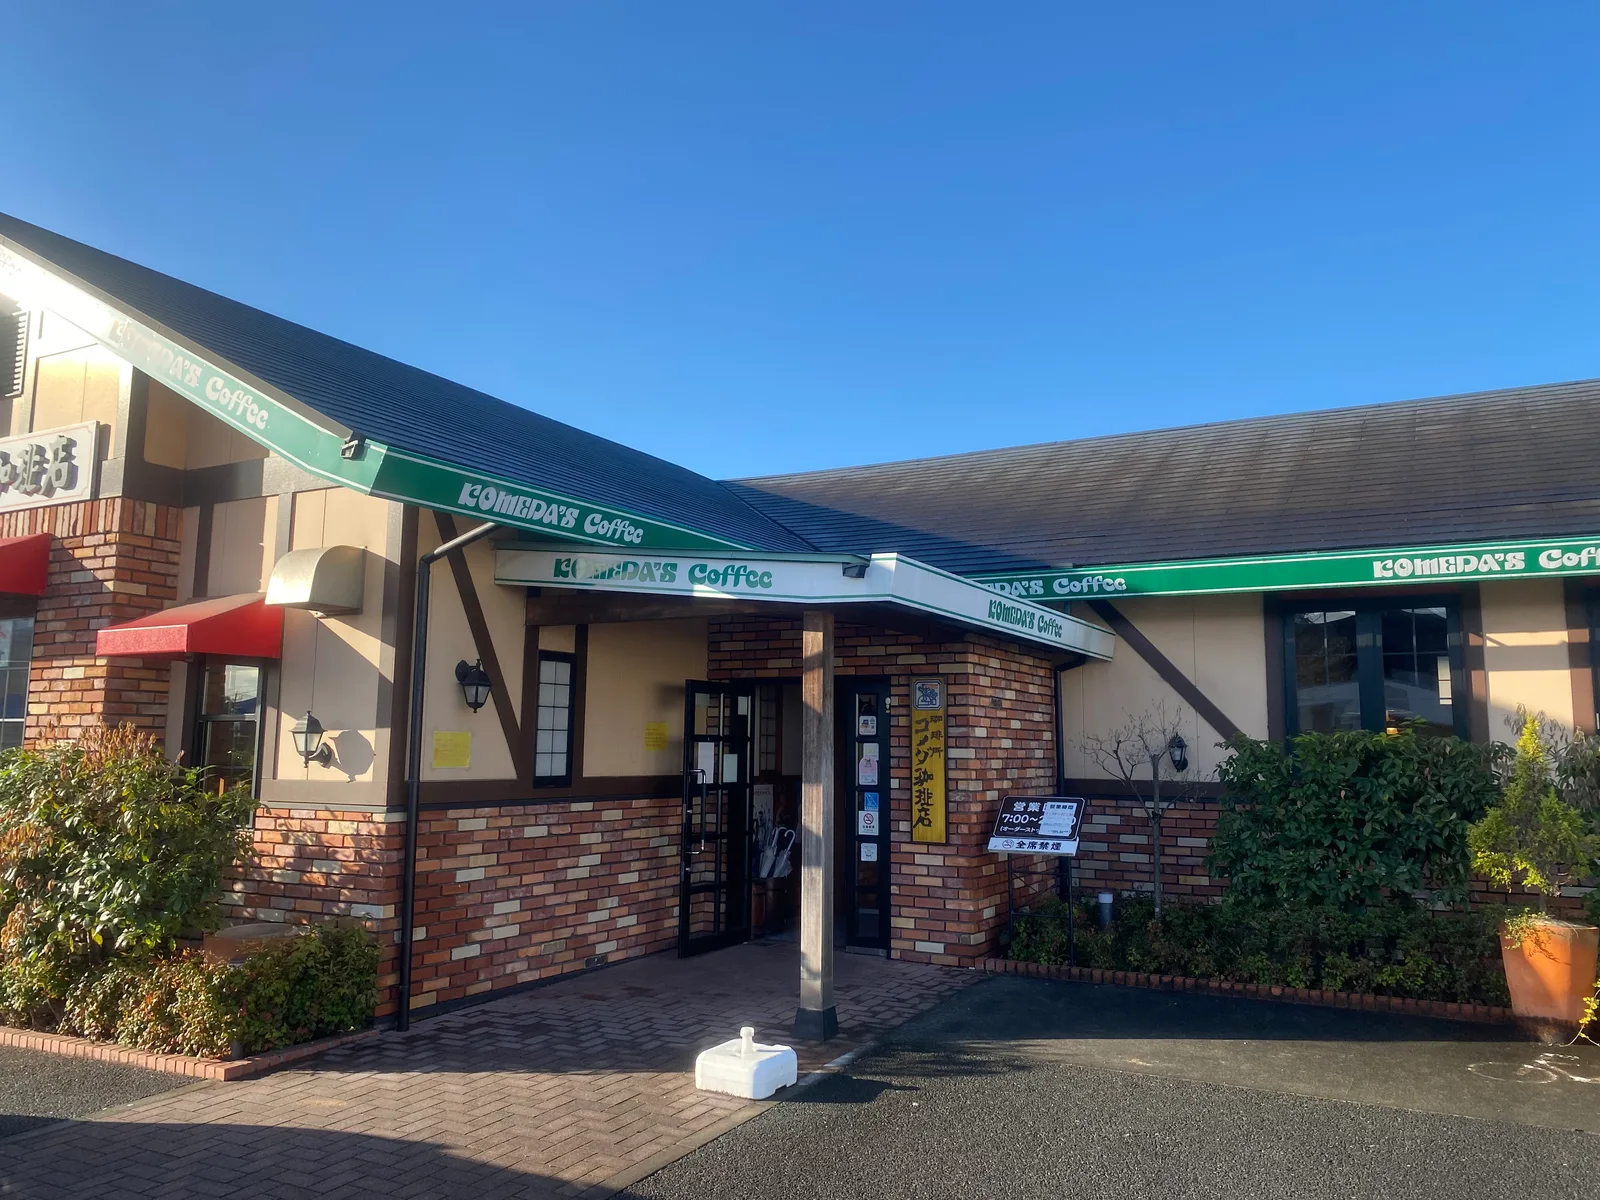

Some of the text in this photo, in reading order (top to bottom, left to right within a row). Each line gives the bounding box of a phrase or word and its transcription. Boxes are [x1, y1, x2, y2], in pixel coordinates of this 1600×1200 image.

[205, 376, 269, 430] Coffee
[457, 482, 644, 544] KOMEDA'S Coffee
[688, 563, 773, 589] Coffee
[1373, 546, 1600, 578] KOMEDA'S Cof
[1052, 575, 1128, 595] Coffee
[988, 599, 1063, 639] KOMEDA'S Coffee
[1015, 840, 1062, 851] 全席禁煙
